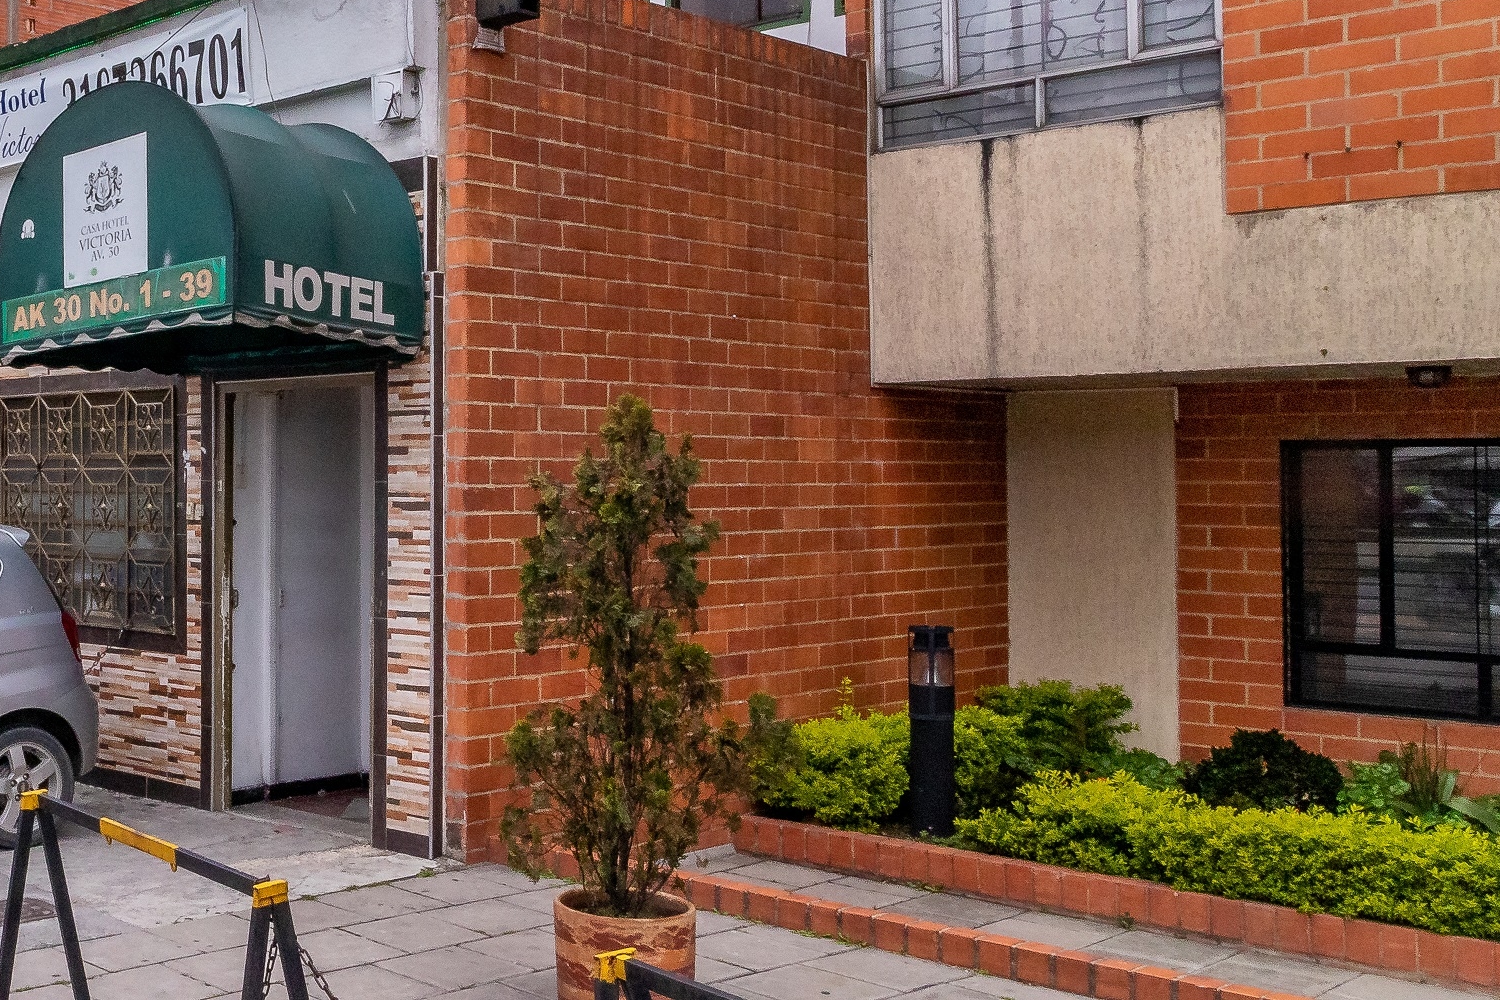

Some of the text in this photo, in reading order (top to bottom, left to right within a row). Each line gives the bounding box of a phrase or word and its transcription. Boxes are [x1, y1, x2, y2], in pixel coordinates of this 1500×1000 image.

[80, 216, 129, 236] CASA HOTEL
[79, 228, 132, 251] VICTORIA
[108, 246, 120, 258] 30
[13, 302, 46, 332] AK
[53, 295, 81, 324] 30
[89, 289, 130, 318] No.
[140, 280, 151, 308] 1
[180, 268, 213, 302] 39
[264, 259, 395, 326] HOTEL
